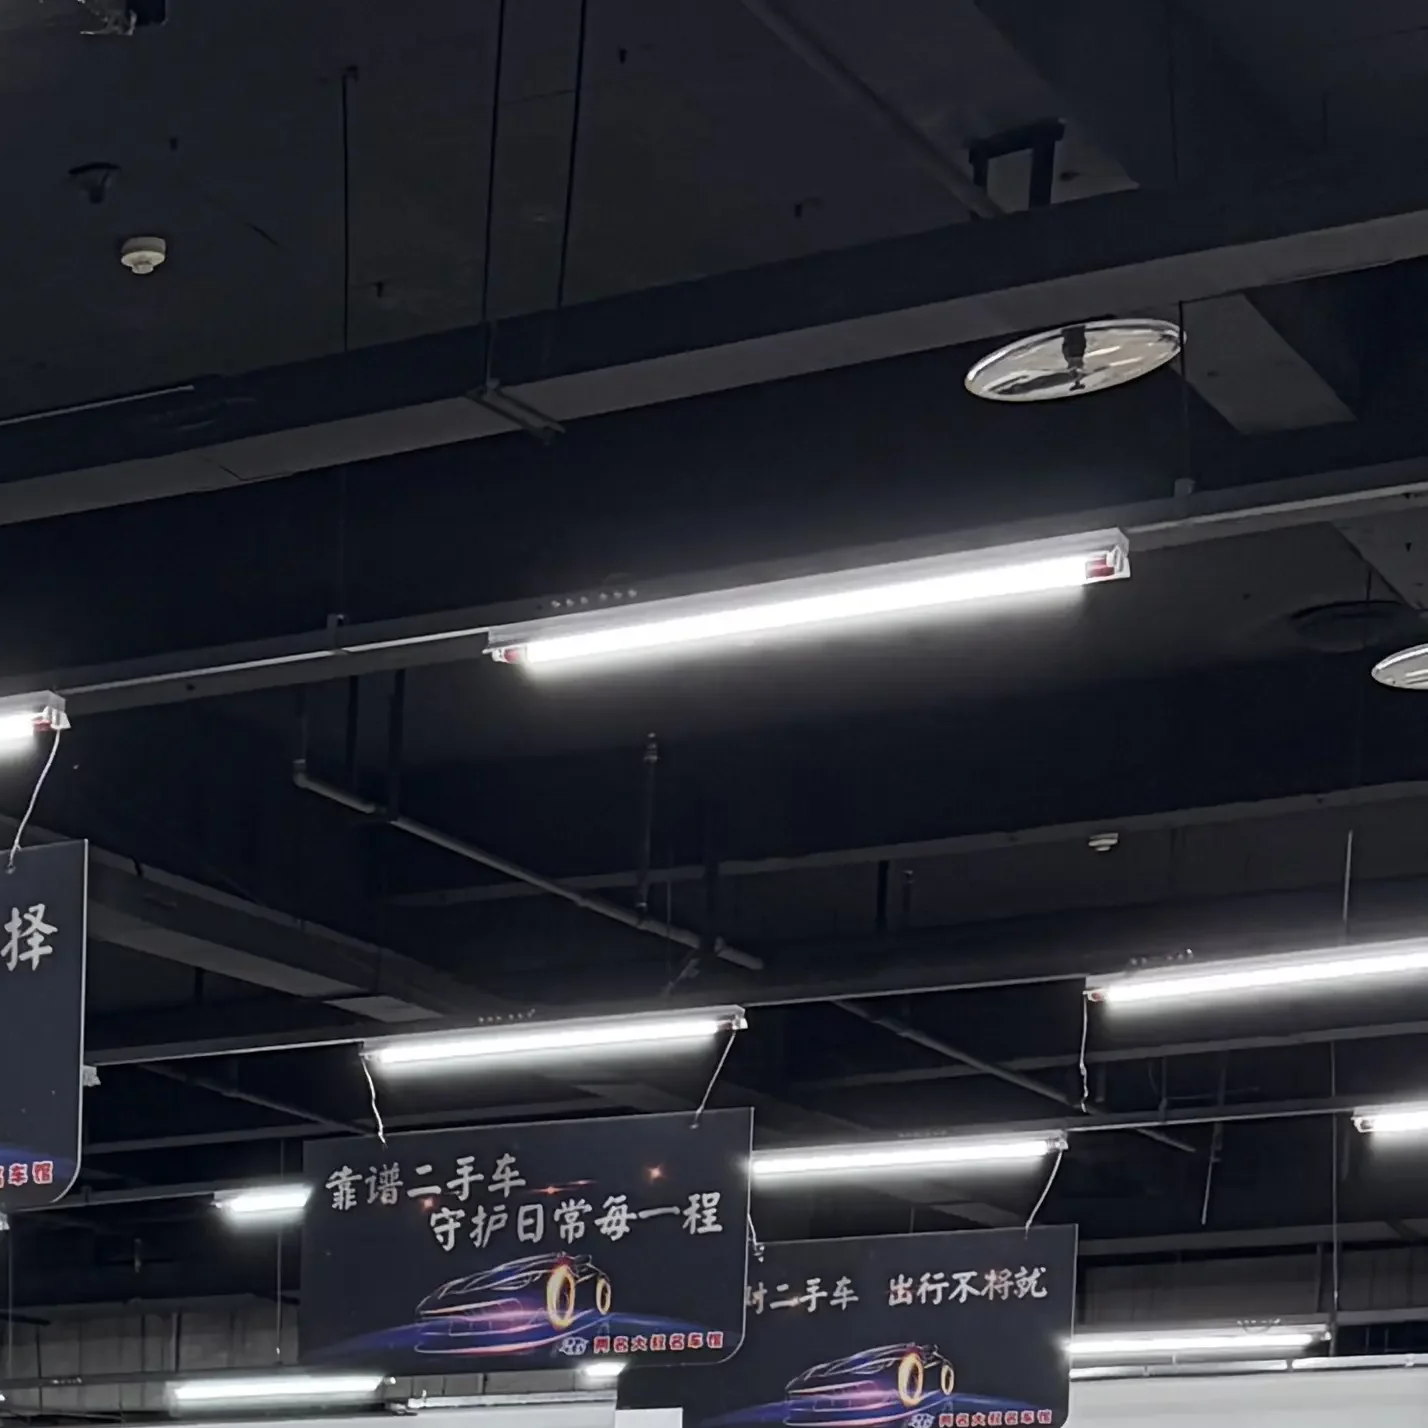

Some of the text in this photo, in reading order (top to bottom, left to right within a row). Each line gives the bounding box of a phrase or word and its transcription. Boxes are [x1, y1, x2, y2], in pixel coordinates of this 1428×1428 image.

[326, 1154, 526, 1212] 靠谱二手车
[429, 1192, 722, 1252] 守护日常每一程
[889, 1266, 1048, 1306] 出行不将就
